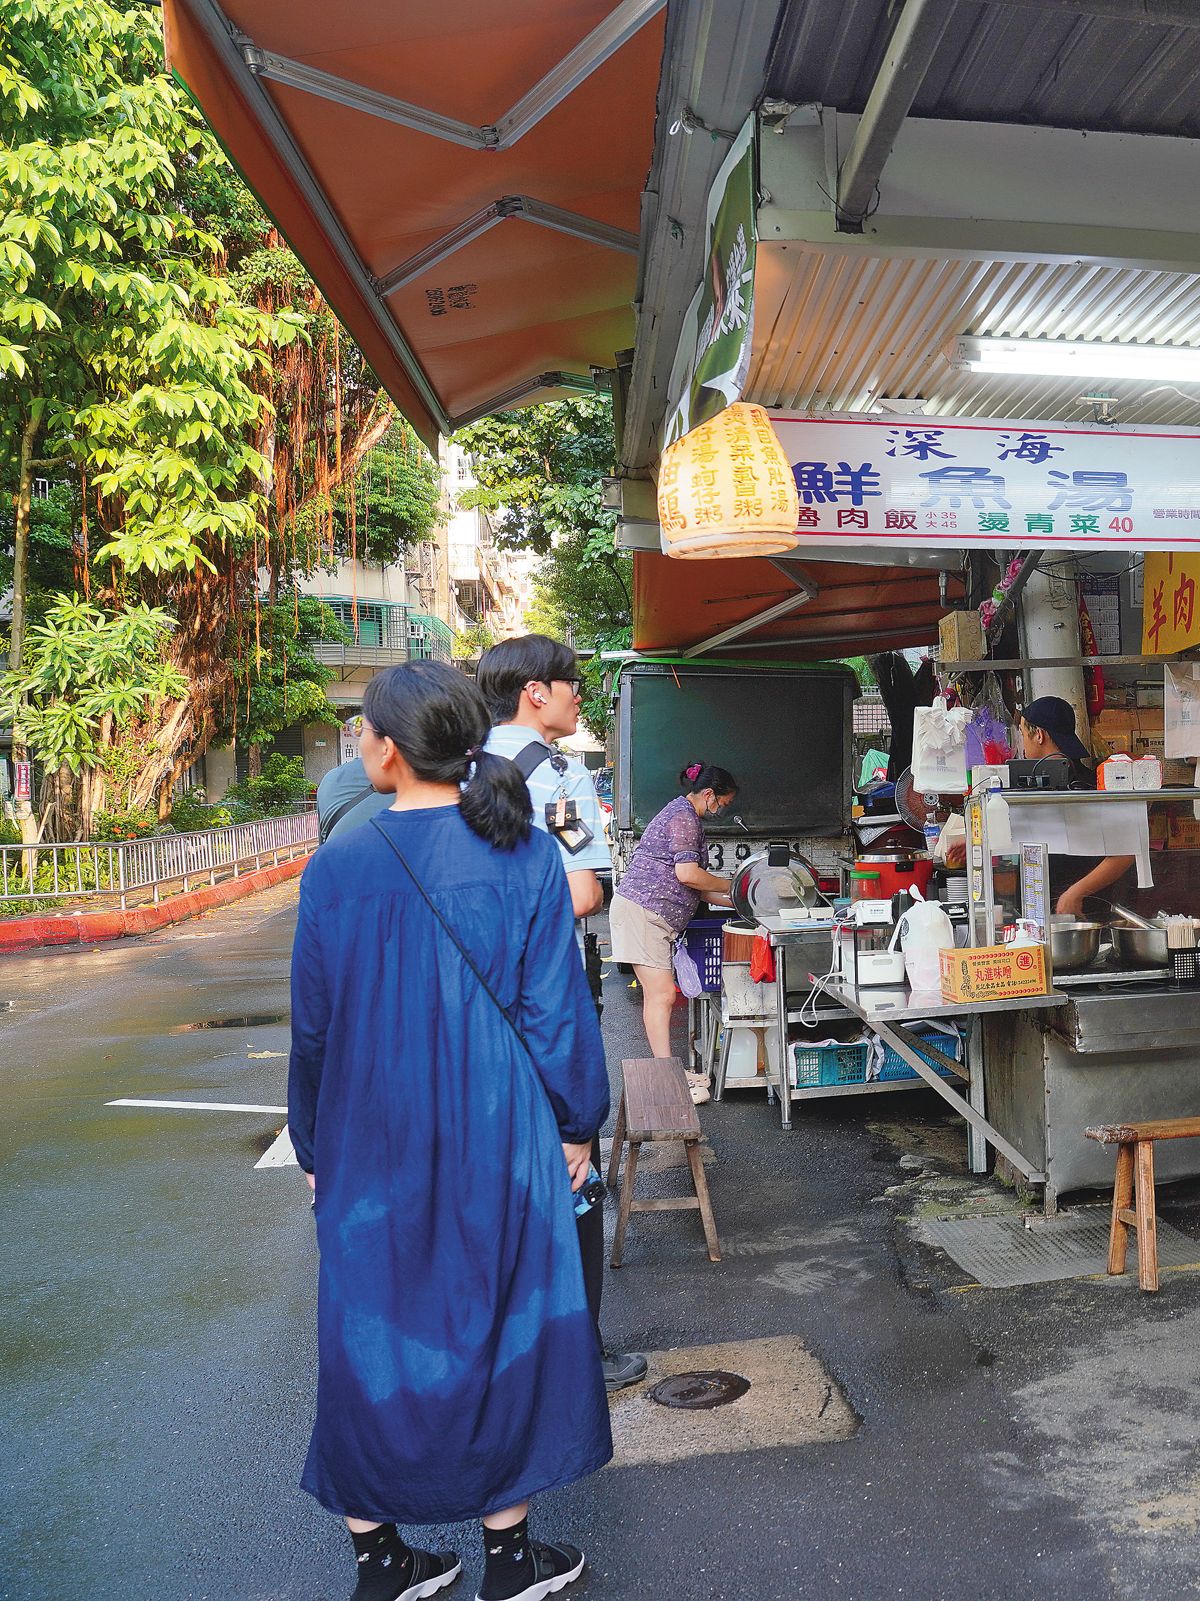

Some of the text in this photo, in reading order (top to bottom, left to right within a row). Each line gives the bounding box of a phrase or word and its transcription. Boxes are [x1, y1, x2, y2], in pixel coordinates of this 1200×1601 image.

[884, 430, 1067, 464] 深海
[792, 461, 1135, 512] 鮮魚湯
[926, 511, 957, 520] 小 35
[926, 520, 958, 530] 大 45
[978, 511, 1134, 534] 燙青菜 40
